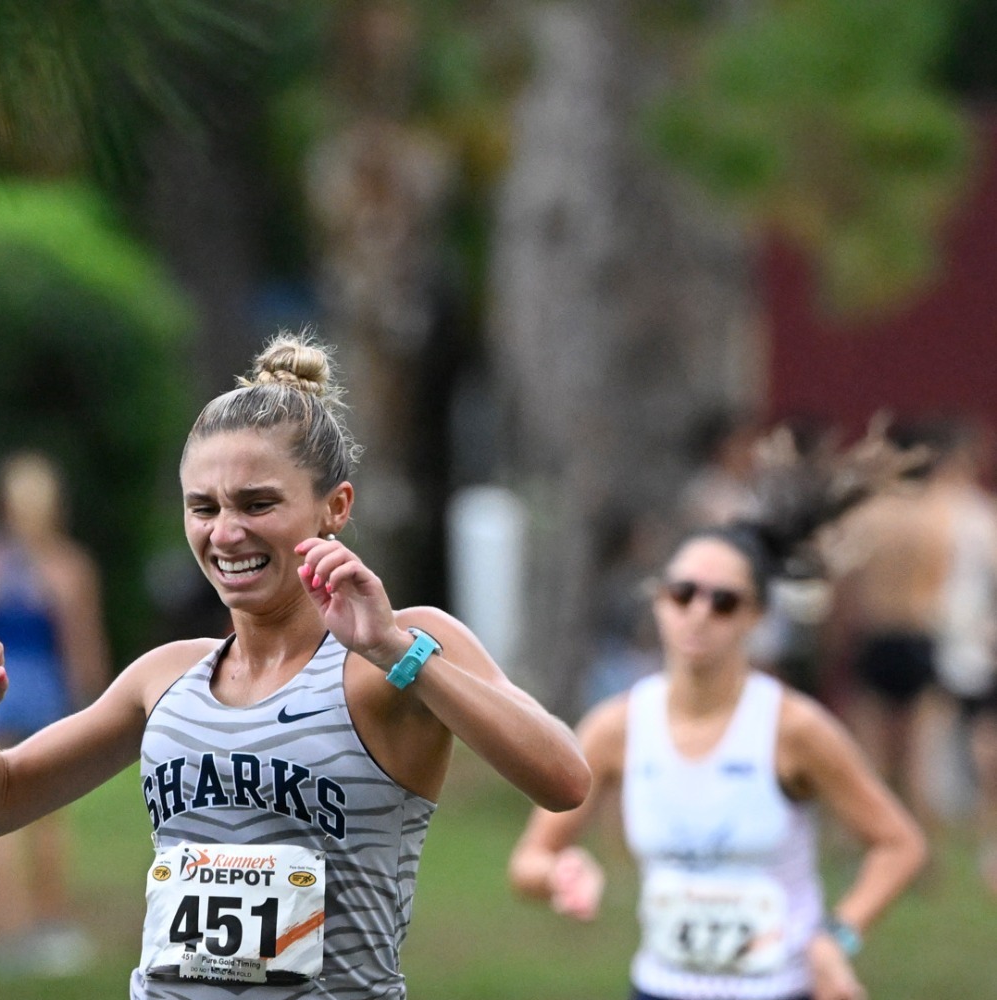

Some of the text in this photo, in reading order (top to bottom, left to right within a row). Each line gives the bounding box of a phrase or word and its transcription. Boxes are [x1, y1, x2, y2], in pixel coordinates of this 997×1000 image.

[143, 752, 347, 840] SHARKS
[213, 854, 277, 869] Runner's
[200, 869, 276, 886] DEPOT
[169, 895, 279, 958] 451
[181, 953, 194, 961] 451
[201, 956, 261, 970] Pure Gold Timing
